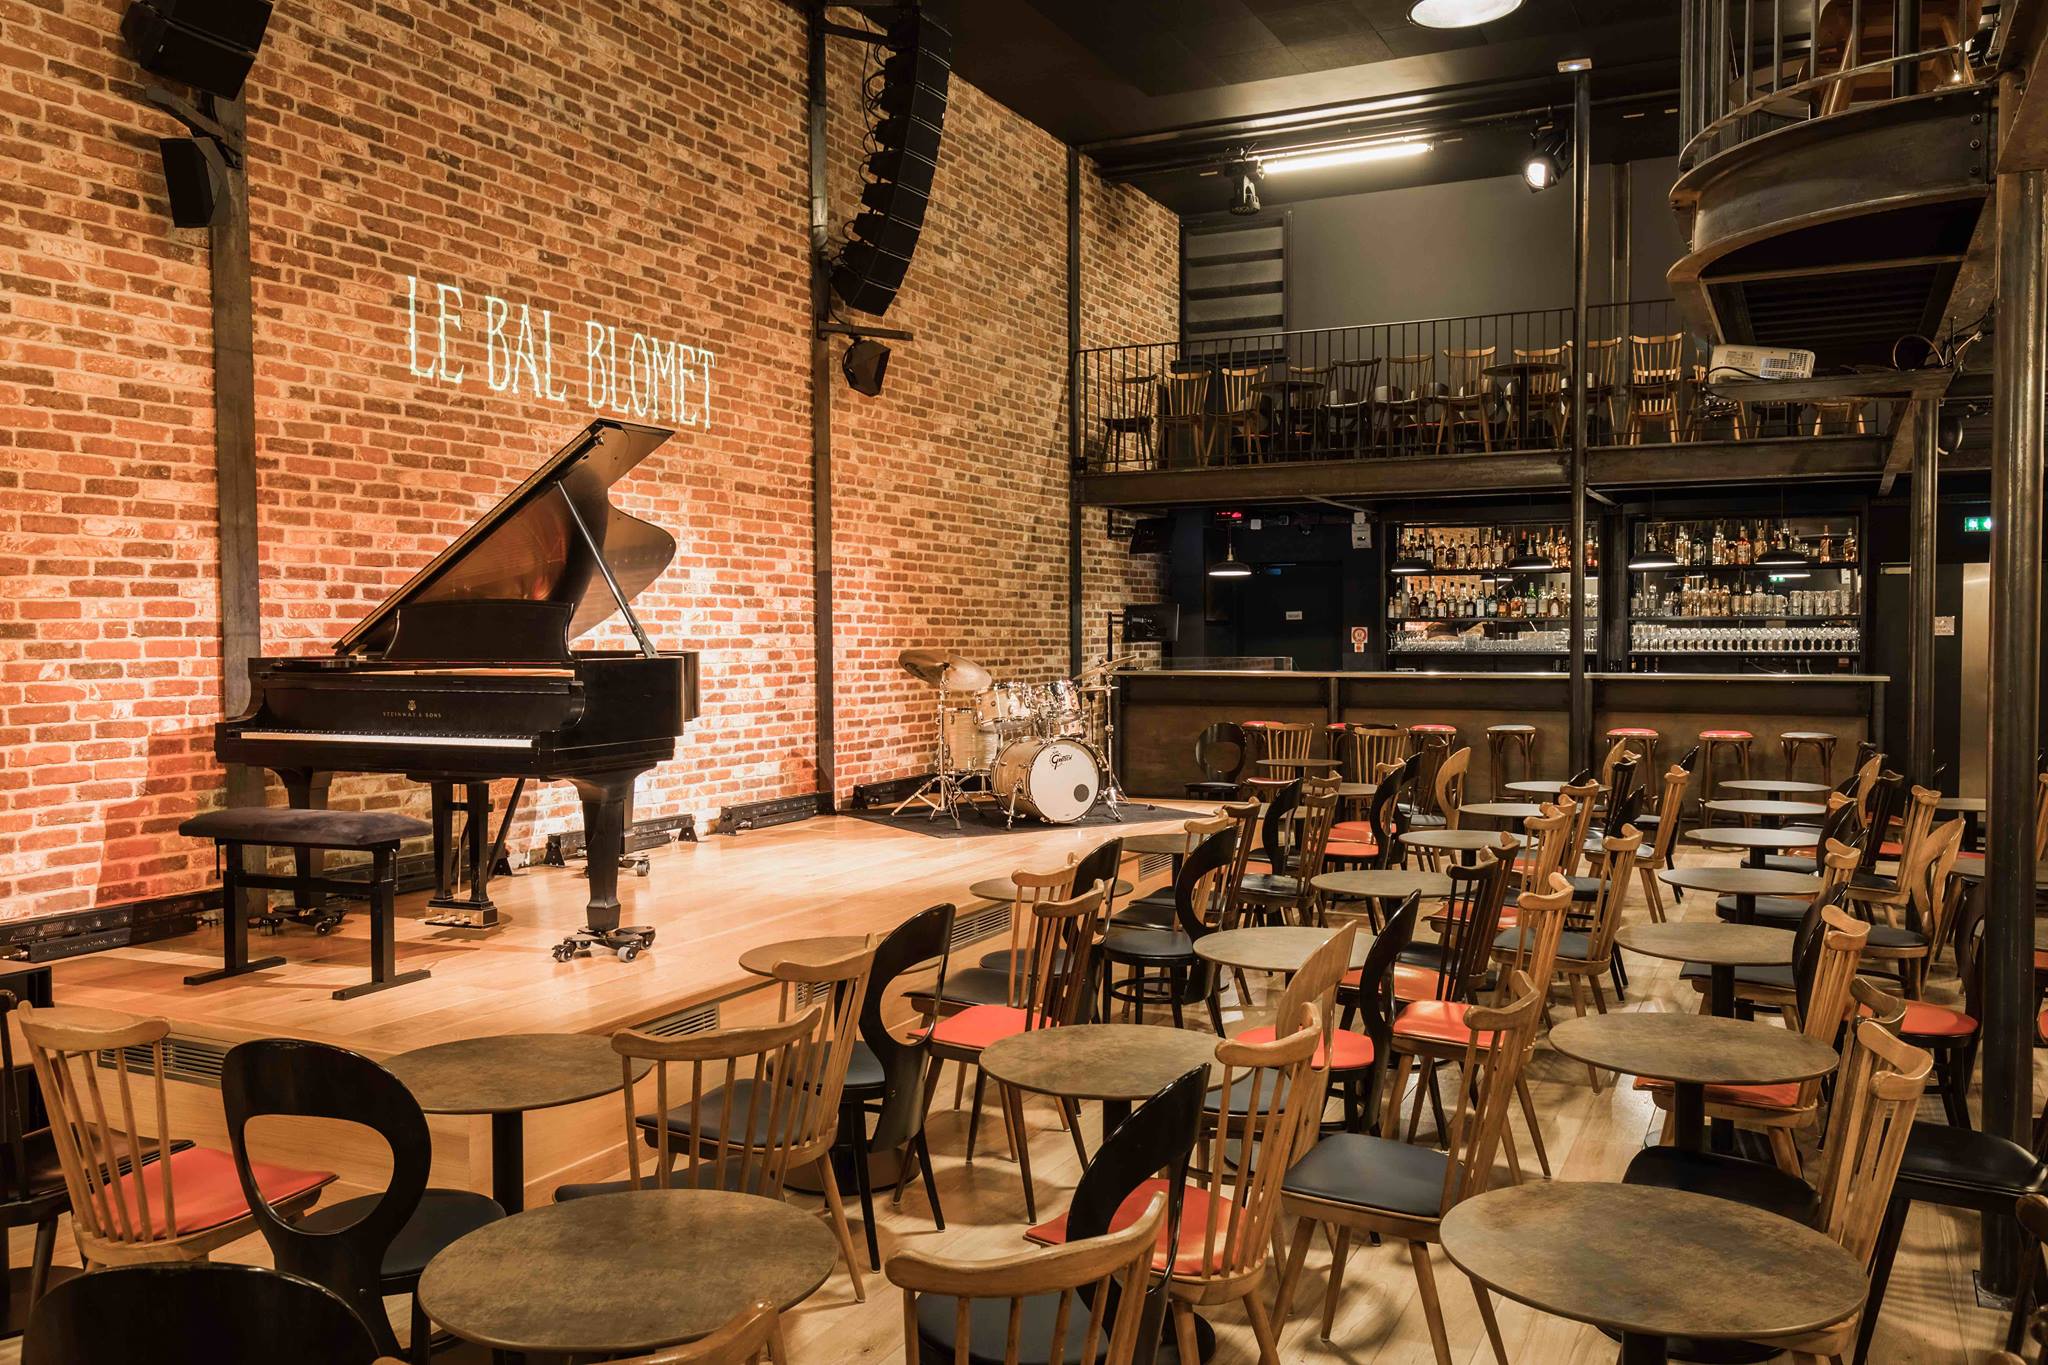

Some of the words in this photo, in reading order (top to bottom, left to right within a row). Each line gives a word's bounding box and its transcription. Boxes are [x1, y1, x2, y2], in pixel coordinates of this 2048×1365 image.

[407, 275, 464, 384] LE
[485, 295, 567, 402] BAL
[585, 320, 716, 430] BLOMET
